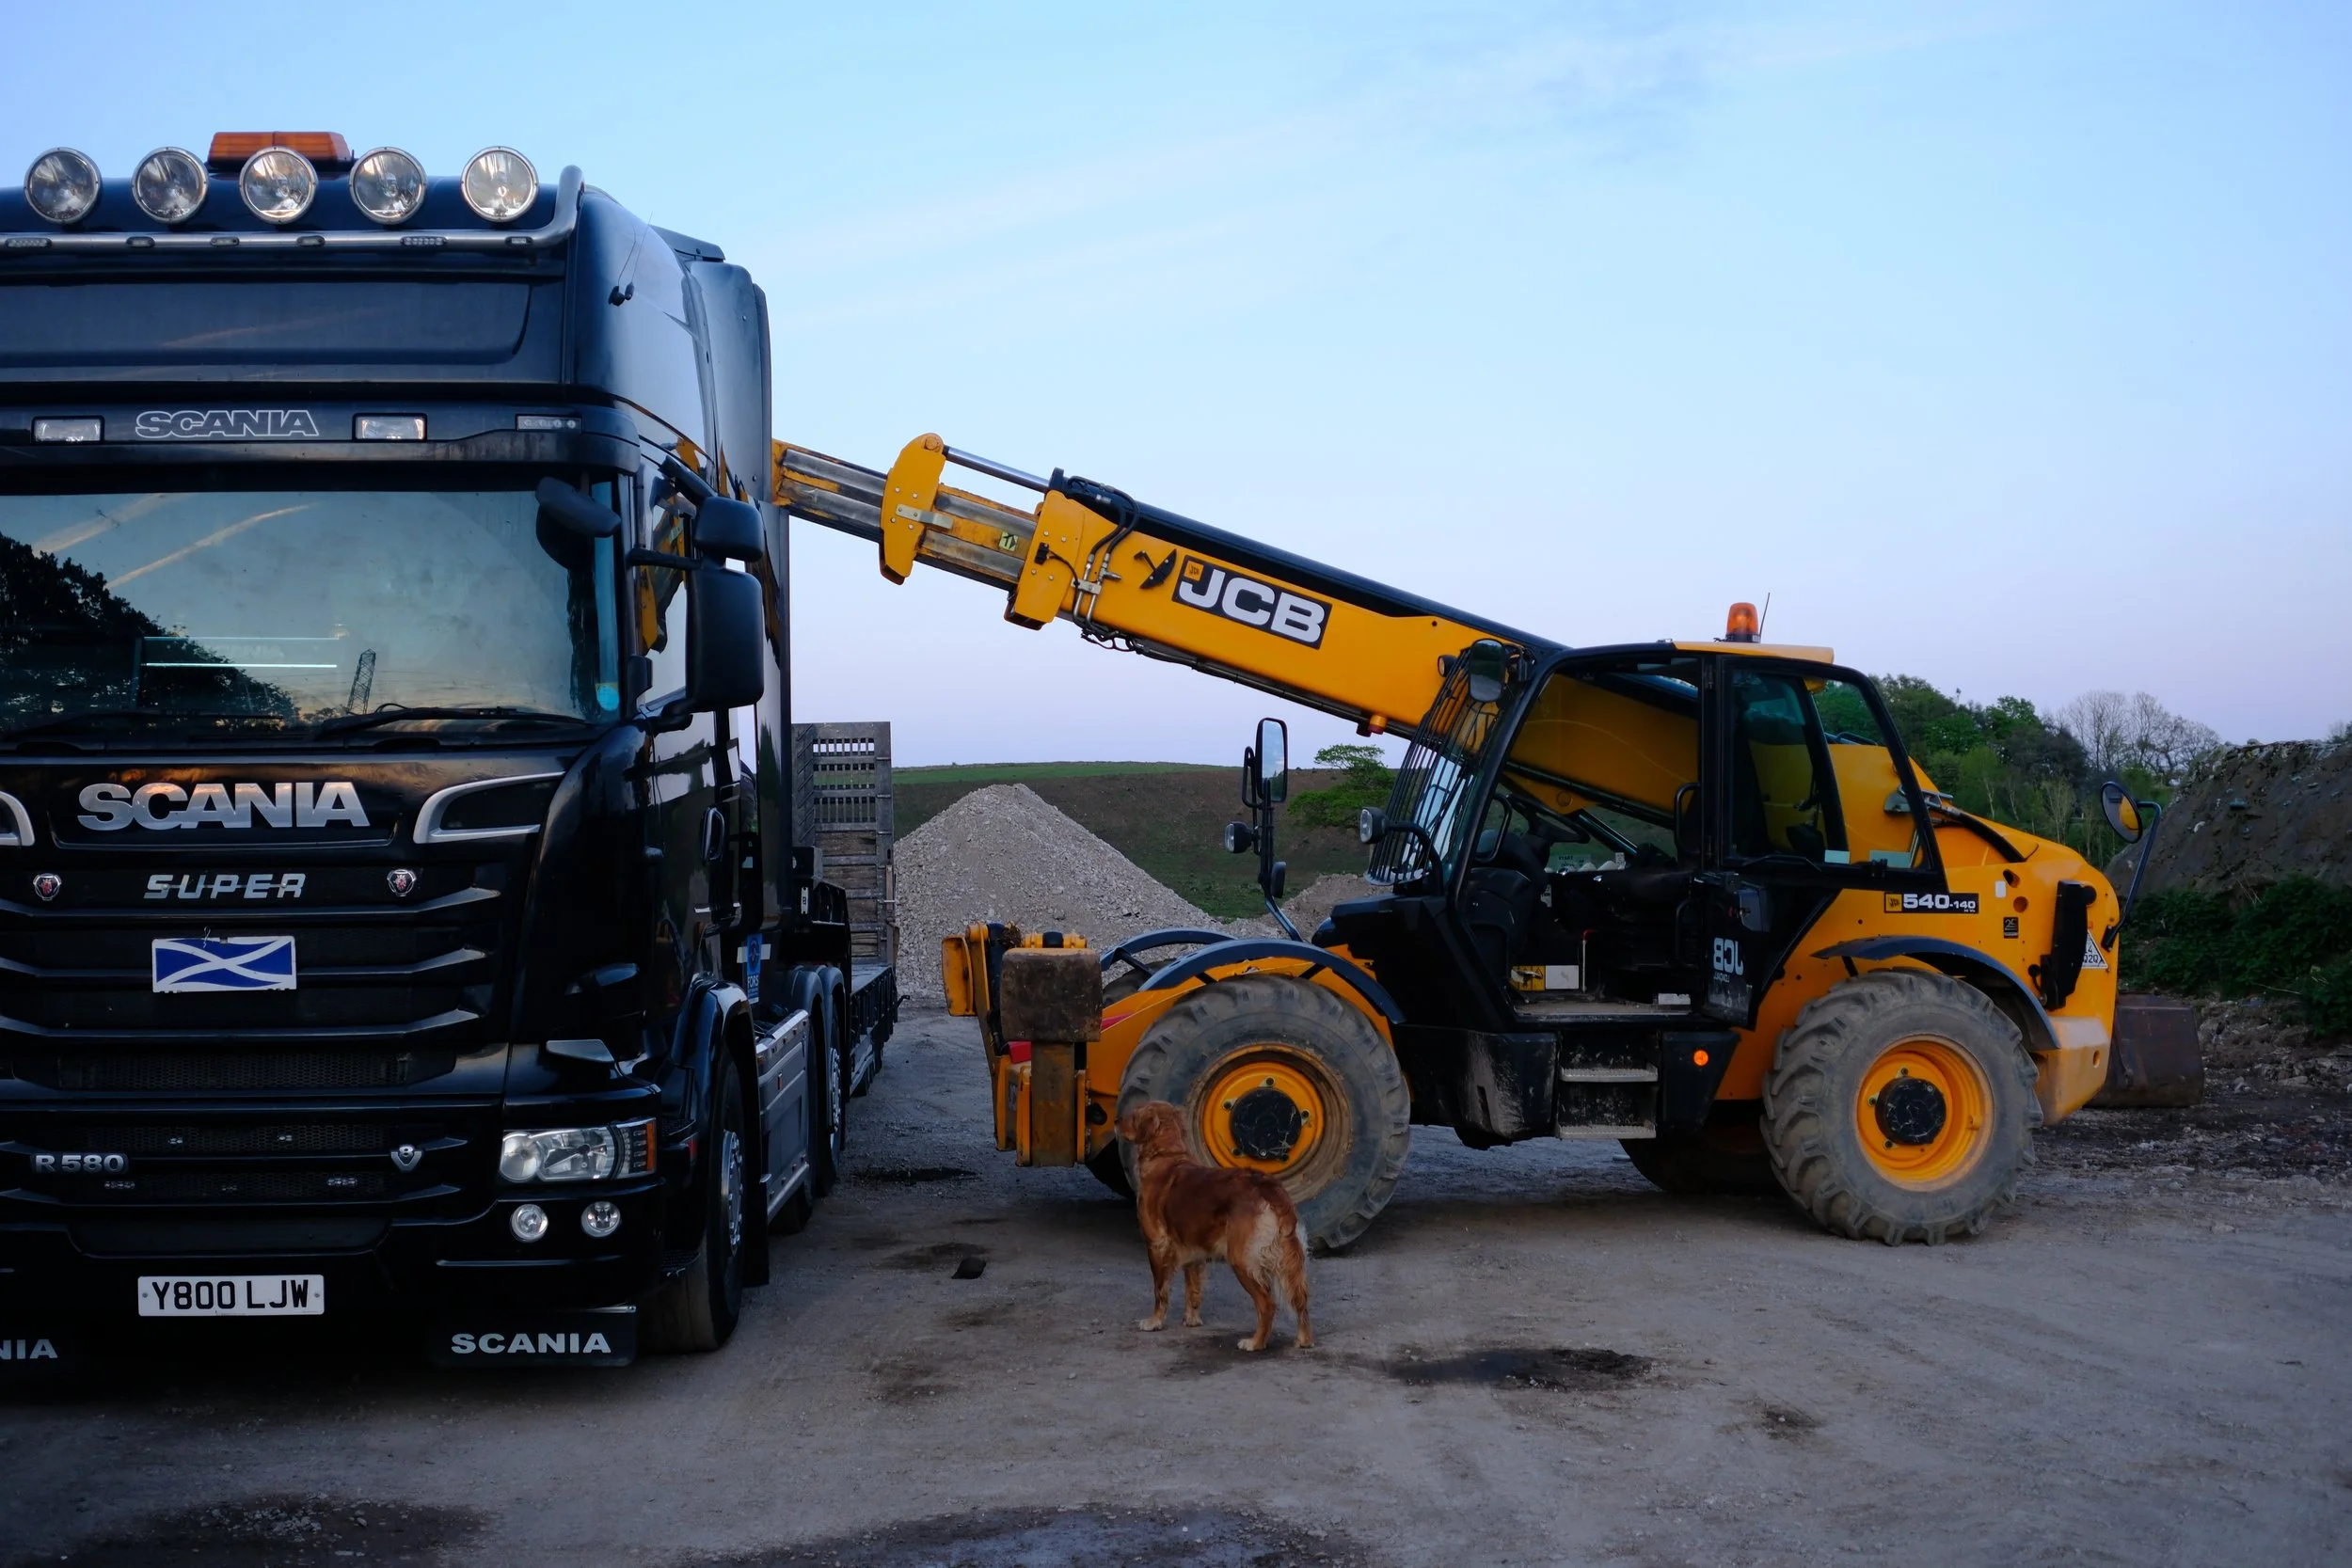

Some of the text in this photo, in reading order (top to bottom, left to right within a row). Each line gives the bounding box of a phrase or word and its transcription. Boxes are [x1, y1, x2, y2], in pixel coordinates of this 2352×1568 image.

[135, 409, 320, 439] SCANIA
[1178, 568, 1326, 643] JCB
[77, 782, 371, 832] SCANIA
[143, 873, 307, 899] SUPER
[1903, 894, 1976, 910] 540-140
[36, 1154, 124, 1172] R 580
[151, 1279, 309, 1310] Y800 LJW
[451, 1333, 612, 1354] SCANIA
